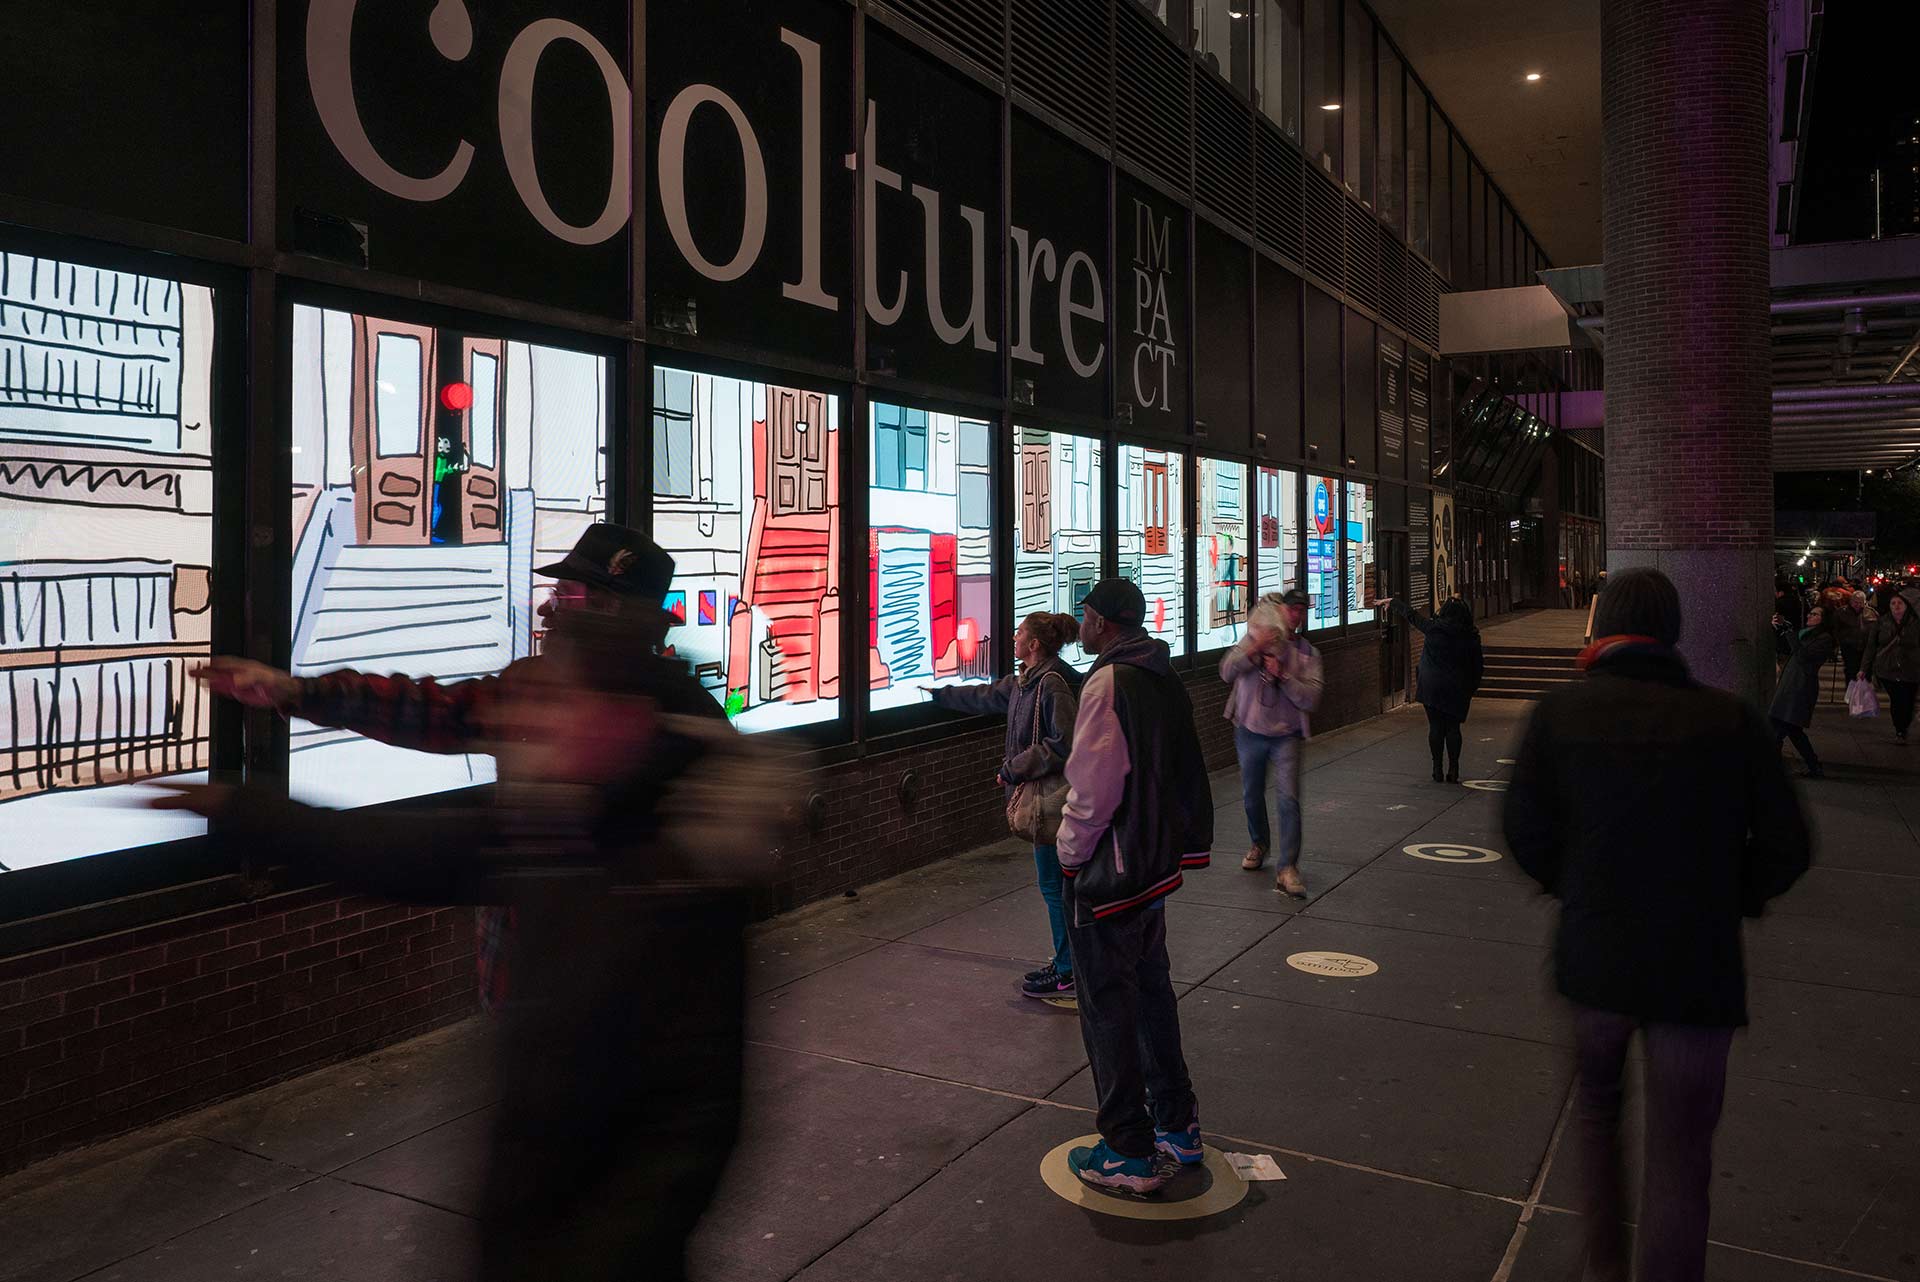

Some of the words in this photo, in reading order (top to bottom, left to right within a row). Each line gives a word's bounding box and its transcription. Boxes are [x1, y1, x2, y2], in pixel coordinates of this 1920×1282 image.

[1133, 199, 1172, 274] IM
[1132, 266, 1176, 347] PA
[1133, 340, 1176, 413] CT
